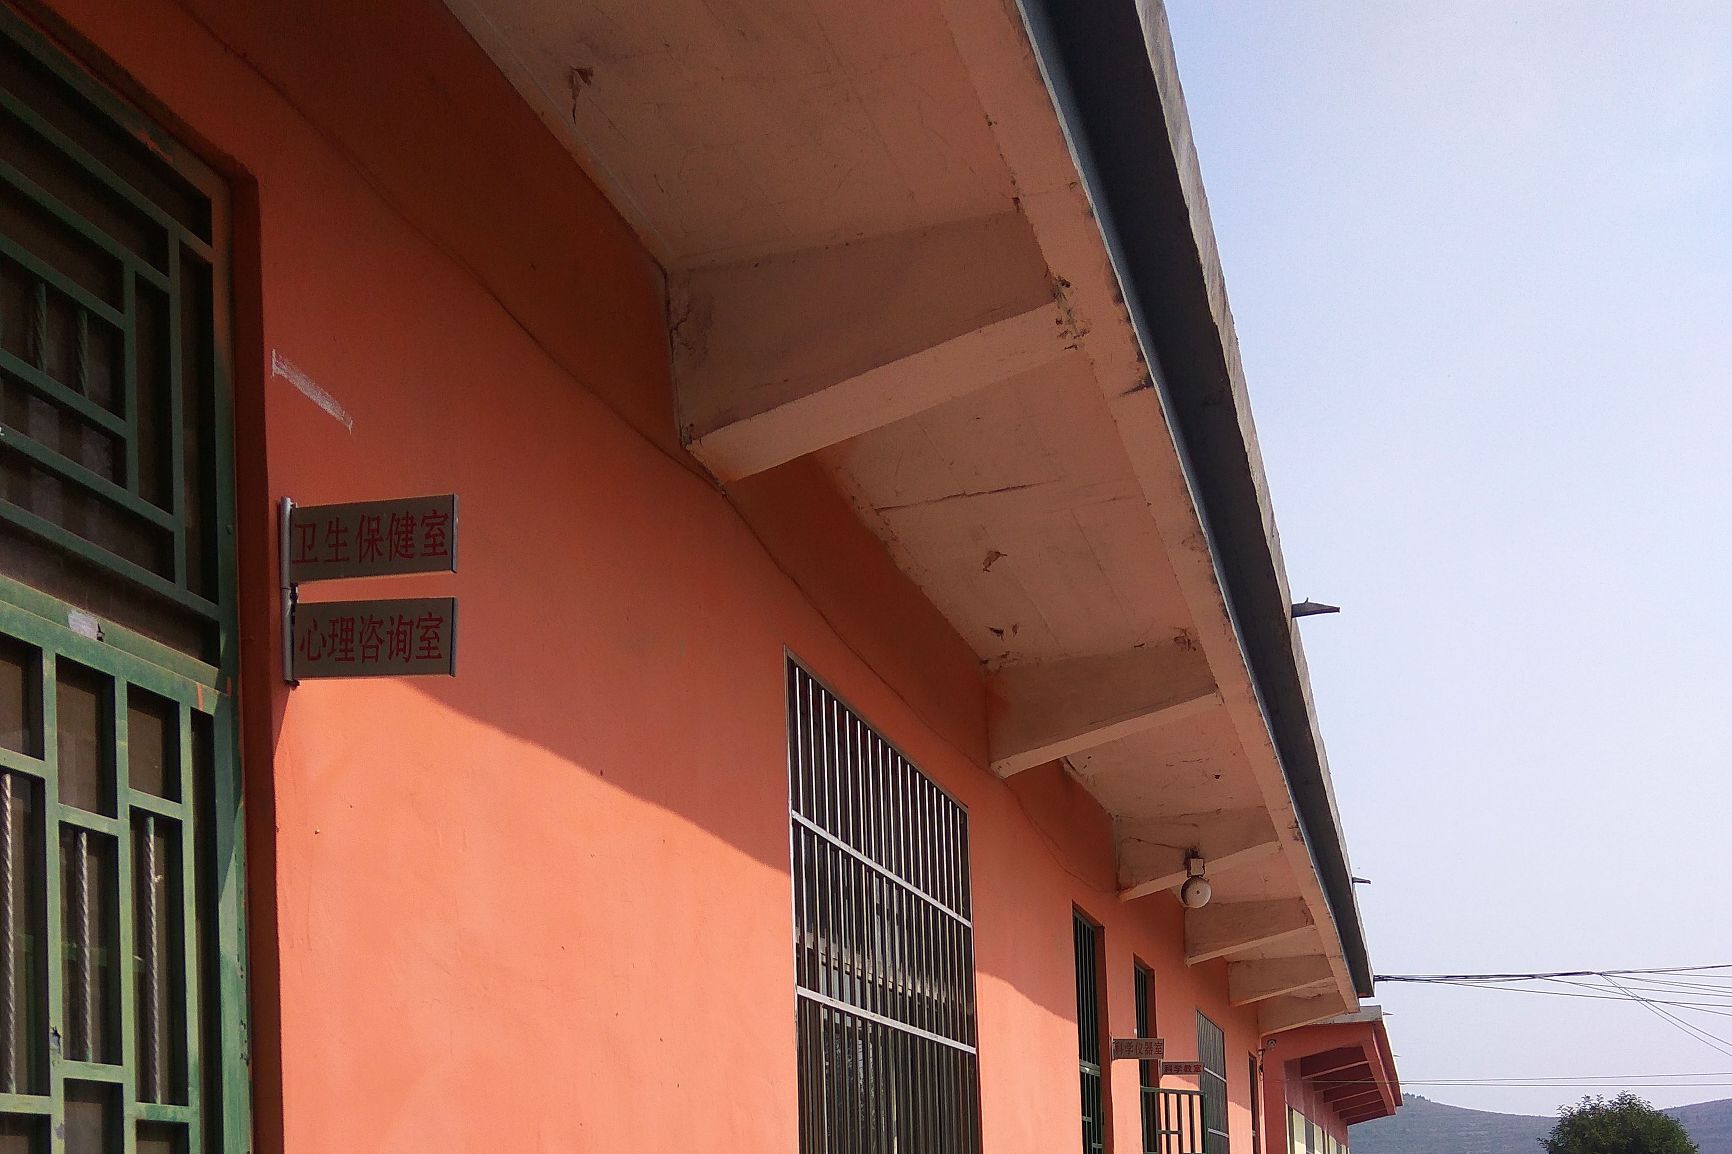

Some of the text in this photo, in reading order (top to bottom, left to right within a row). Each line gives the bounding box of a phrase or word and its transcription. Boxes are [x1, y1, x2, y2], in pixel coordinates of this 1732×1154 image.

[293, 509, 449, 563] 卫生保健室
[302, 613, 443, 664] 心理咨询室
[1114, 1041, 1163, 1056] 科学仪器室
[1164, 1063, 1202, 1074] 科学教室
